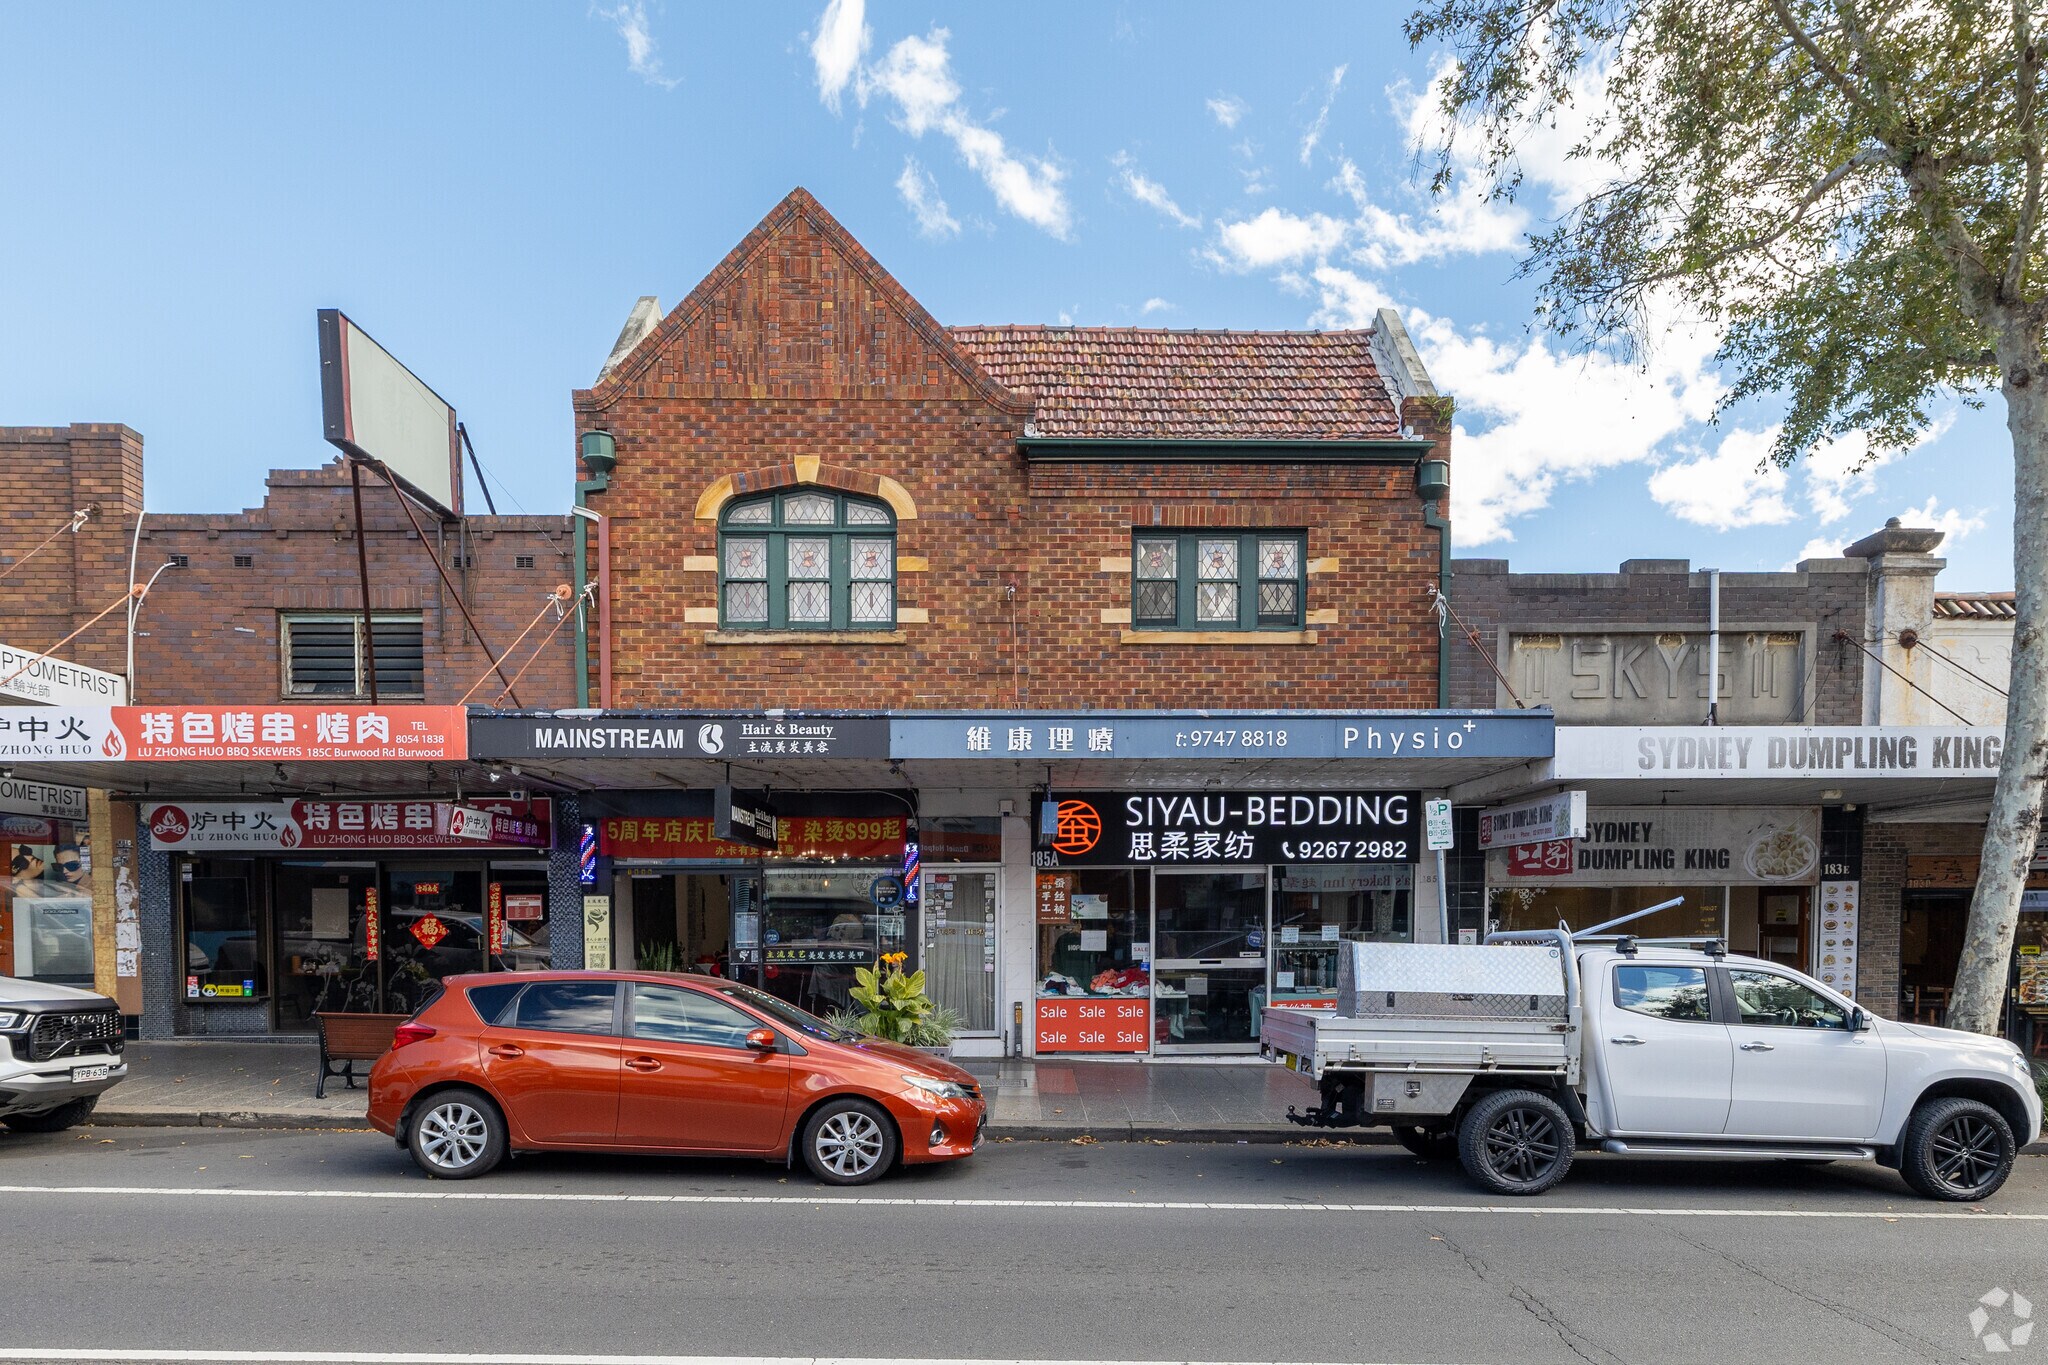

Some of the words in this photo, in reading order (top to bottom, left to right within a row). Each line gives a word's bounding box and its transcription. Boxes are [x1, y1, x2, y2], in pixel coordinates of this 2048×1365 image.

[411, 721, 428, 731] TEL
[742, 723, 771, 735] Hair
[775, 724, 785, 735] &
[789, 723, 834, 738] Beauty
[396, 734, 419, 744] 8054
[421, 734, 444, 744] 1838
[535, 728, 684, 749] MAINSTREAM
[966, 726, 1114, 752] 維康理療
[1241, 730, 1288, 747] 8818
[61, 745, 91, 754] HUO
[138, 747, 151, 757] LU
[155, 747, 196, 757] ZHONG
[199, 747, 224, 757] HUO
[227, 747, 250, 758] BBQ
[252, 746, 302, 757] SKEWERS
[307, 747, 332, 758] 185C
[335, 747, 380, 758] Burwood
[382, 747, 396, 758] Rd
[398, 748, 444, 758] Burwood
[1637, 736, 1753, 770] SYDNEY
[1767, 736, 1918, 770] DUMPLING
[1932, 735, 2003, 770] KING
[1126, 795, 1408, 827] SIYAU-BEDDING
[190, 833, 204, 841] LU
[209, 833, 249, 841] ZHONG
[254, 833, 278, 841] HUO
[314, 835, 326, 843] LU
[330, 835, 365, 844] ZHONG
[368, 835, 392, 844] HUO
[394, 835, 415, 844] BBQ
[417, 835, 462, 844] SKEWERS
[1128, 830, 1255, 861] 思柔家纺
[1299, 841, 1348, 859] 9267
[1355, 841, 1407, 859] 2982
[1031, 851, 1059, 867] 185A
[1578, 848, 1675, 870] DUMPLING
[1684, 848, 1730, 870] KING
[1824, 862, 1850, 876] 183E
[1040, 1006, 1067, 1018] Sale
[1079, 1006, 1106, 1018] Sale
[1117, 1006, 1144, 1018] Sale
[1040, 1031, 1067, 1043] Sale
[1079, 1031, 1105, 1043] Sale
[1117, 1031, 1143, 1043] Sale
